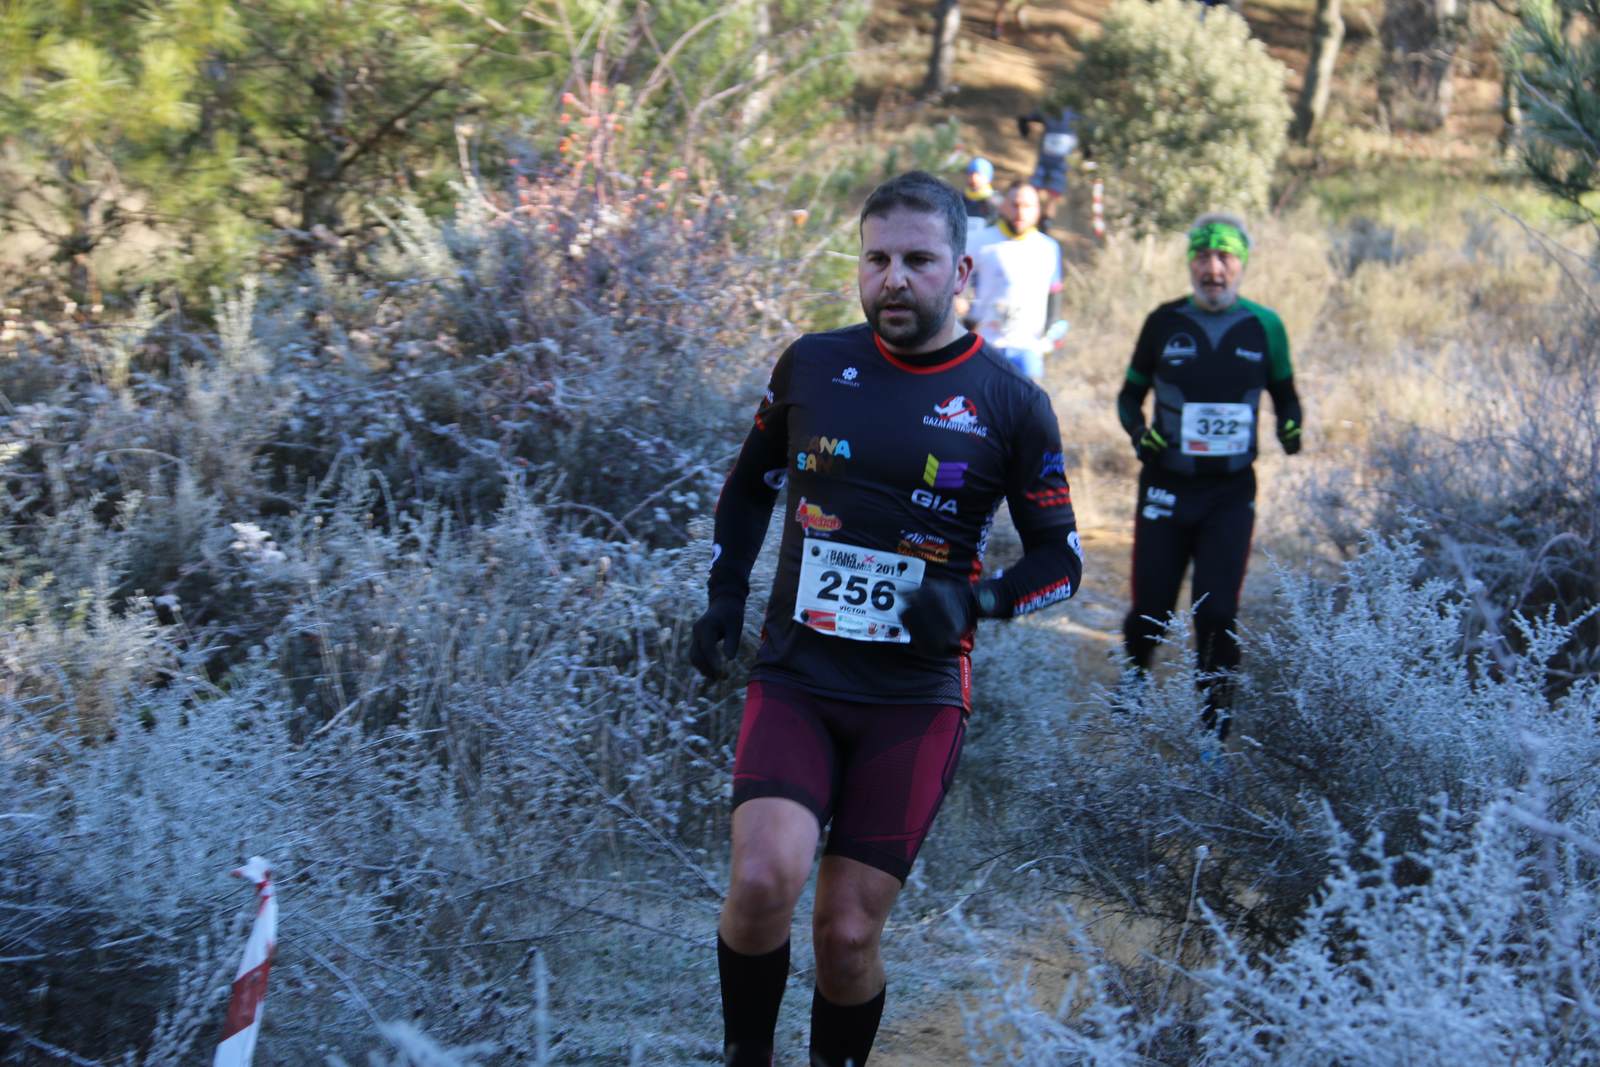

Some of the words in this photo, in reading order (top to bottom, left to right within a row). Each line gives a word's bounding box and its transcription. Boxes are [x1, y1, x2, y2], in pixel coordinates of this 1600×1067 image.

[1196, 418, 1239, 436] 322
[911, 488, 958, 514] GIA
[816, 570, 897, 612] 256
[839, 605, 867, 616] VICTOR
